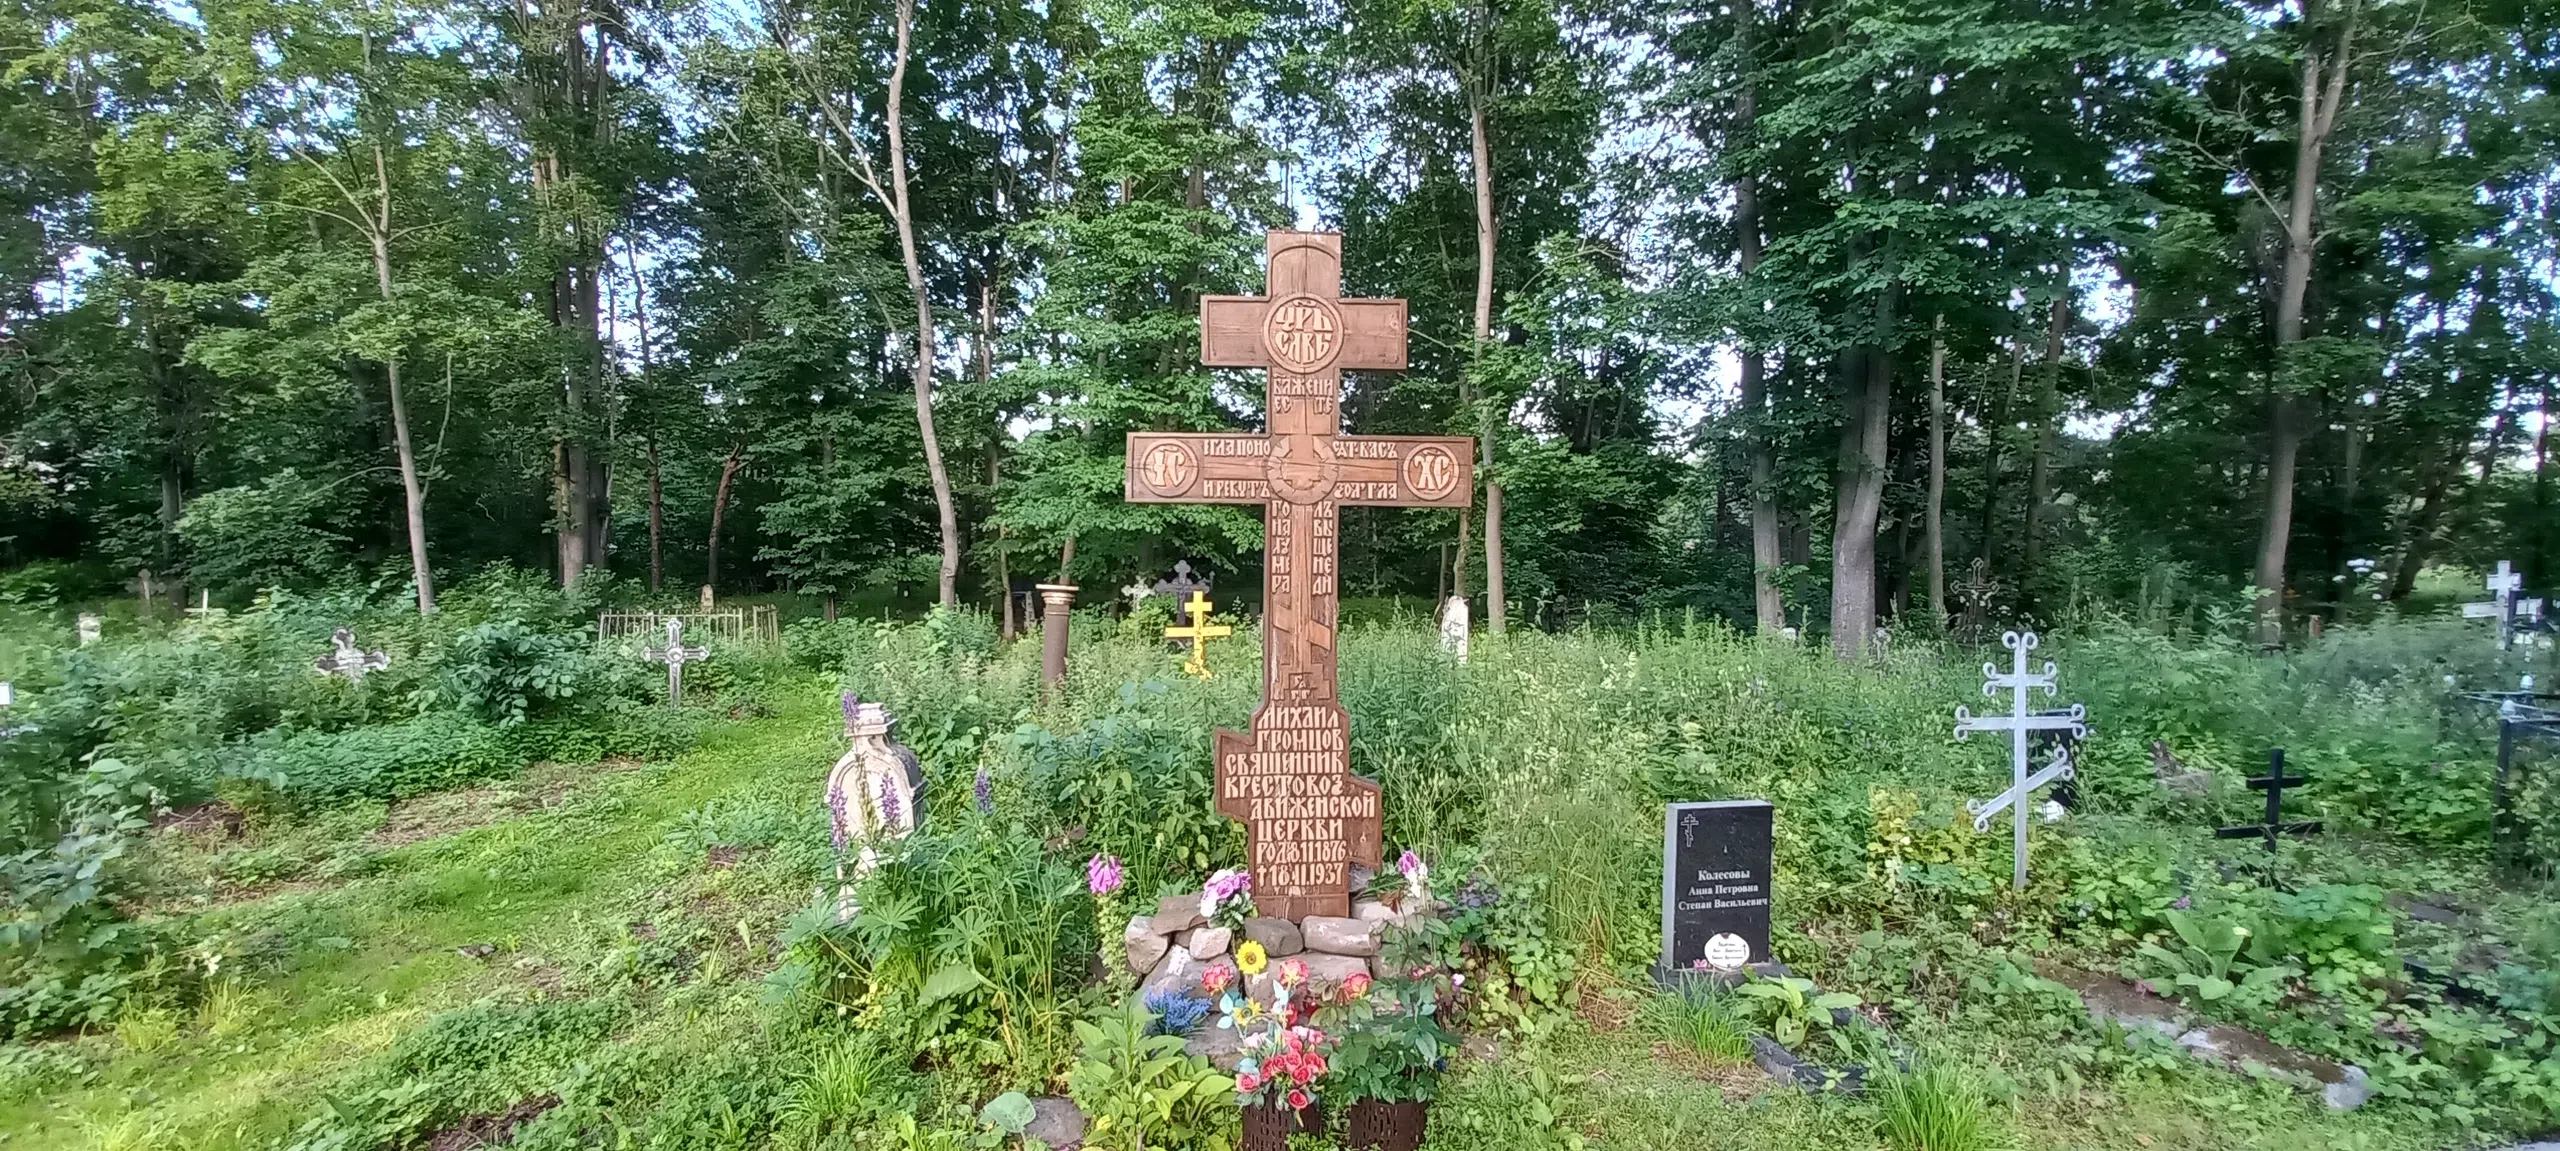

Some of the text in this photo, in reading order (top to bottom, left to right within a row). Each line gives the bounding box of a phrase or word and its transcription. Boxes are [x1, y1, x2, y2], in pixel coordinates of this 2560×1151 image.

[1257, 702, 1339, 729] МИХАИЛ
[1257, 729, 1344, 752] ГРОМЦОВ
[1225, 752, 1344, 776] СВЯЩЕННИК
[1250, 791, 1375, 820] ДВИЖЕНСКОЙ
[1257, 818, 1342, 842] ЦЕРКВИ
[1697, 869, 1751, 881] Колесовы
[1688, 884, 1759, 896] Анна Петровна
[1678, 898, 1768, 911] Степан Васильевич
